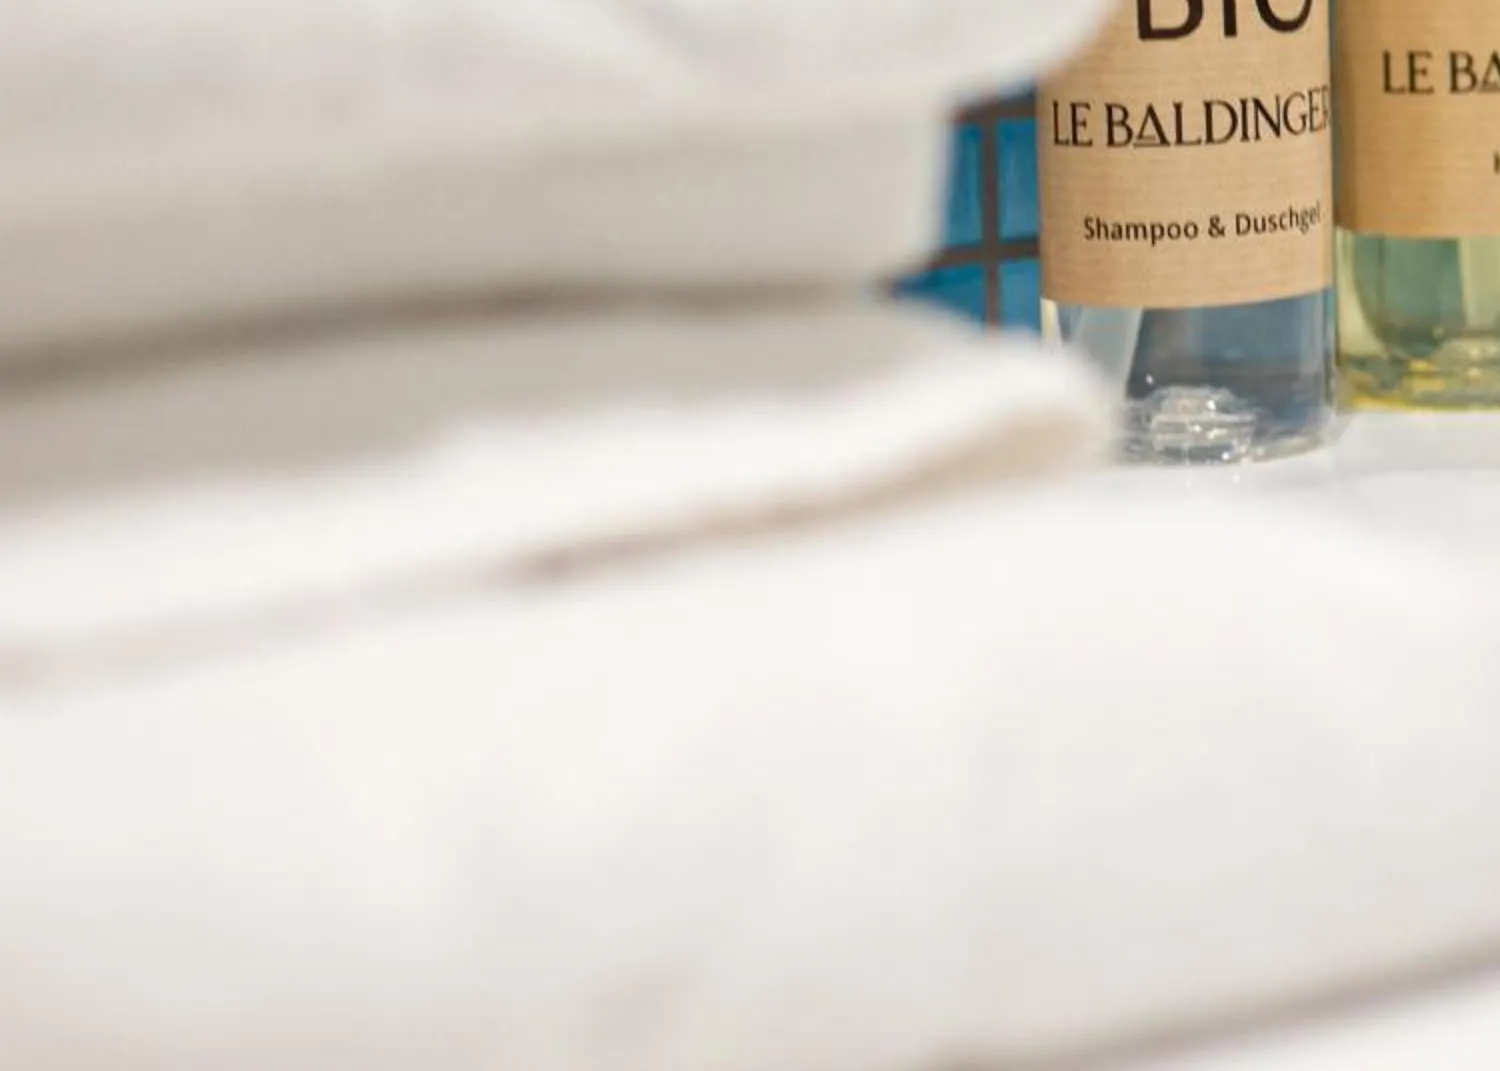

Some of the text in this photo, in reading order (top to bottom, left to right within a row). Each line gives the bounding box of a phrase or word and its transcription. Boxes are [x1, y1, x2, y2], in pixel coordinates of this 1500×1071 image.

[1381, 49, 1435, 96] LE
[1051, 99, 1093, 148] LE
[1083, 199, 1321, 247] Shampoo & Duschgel
